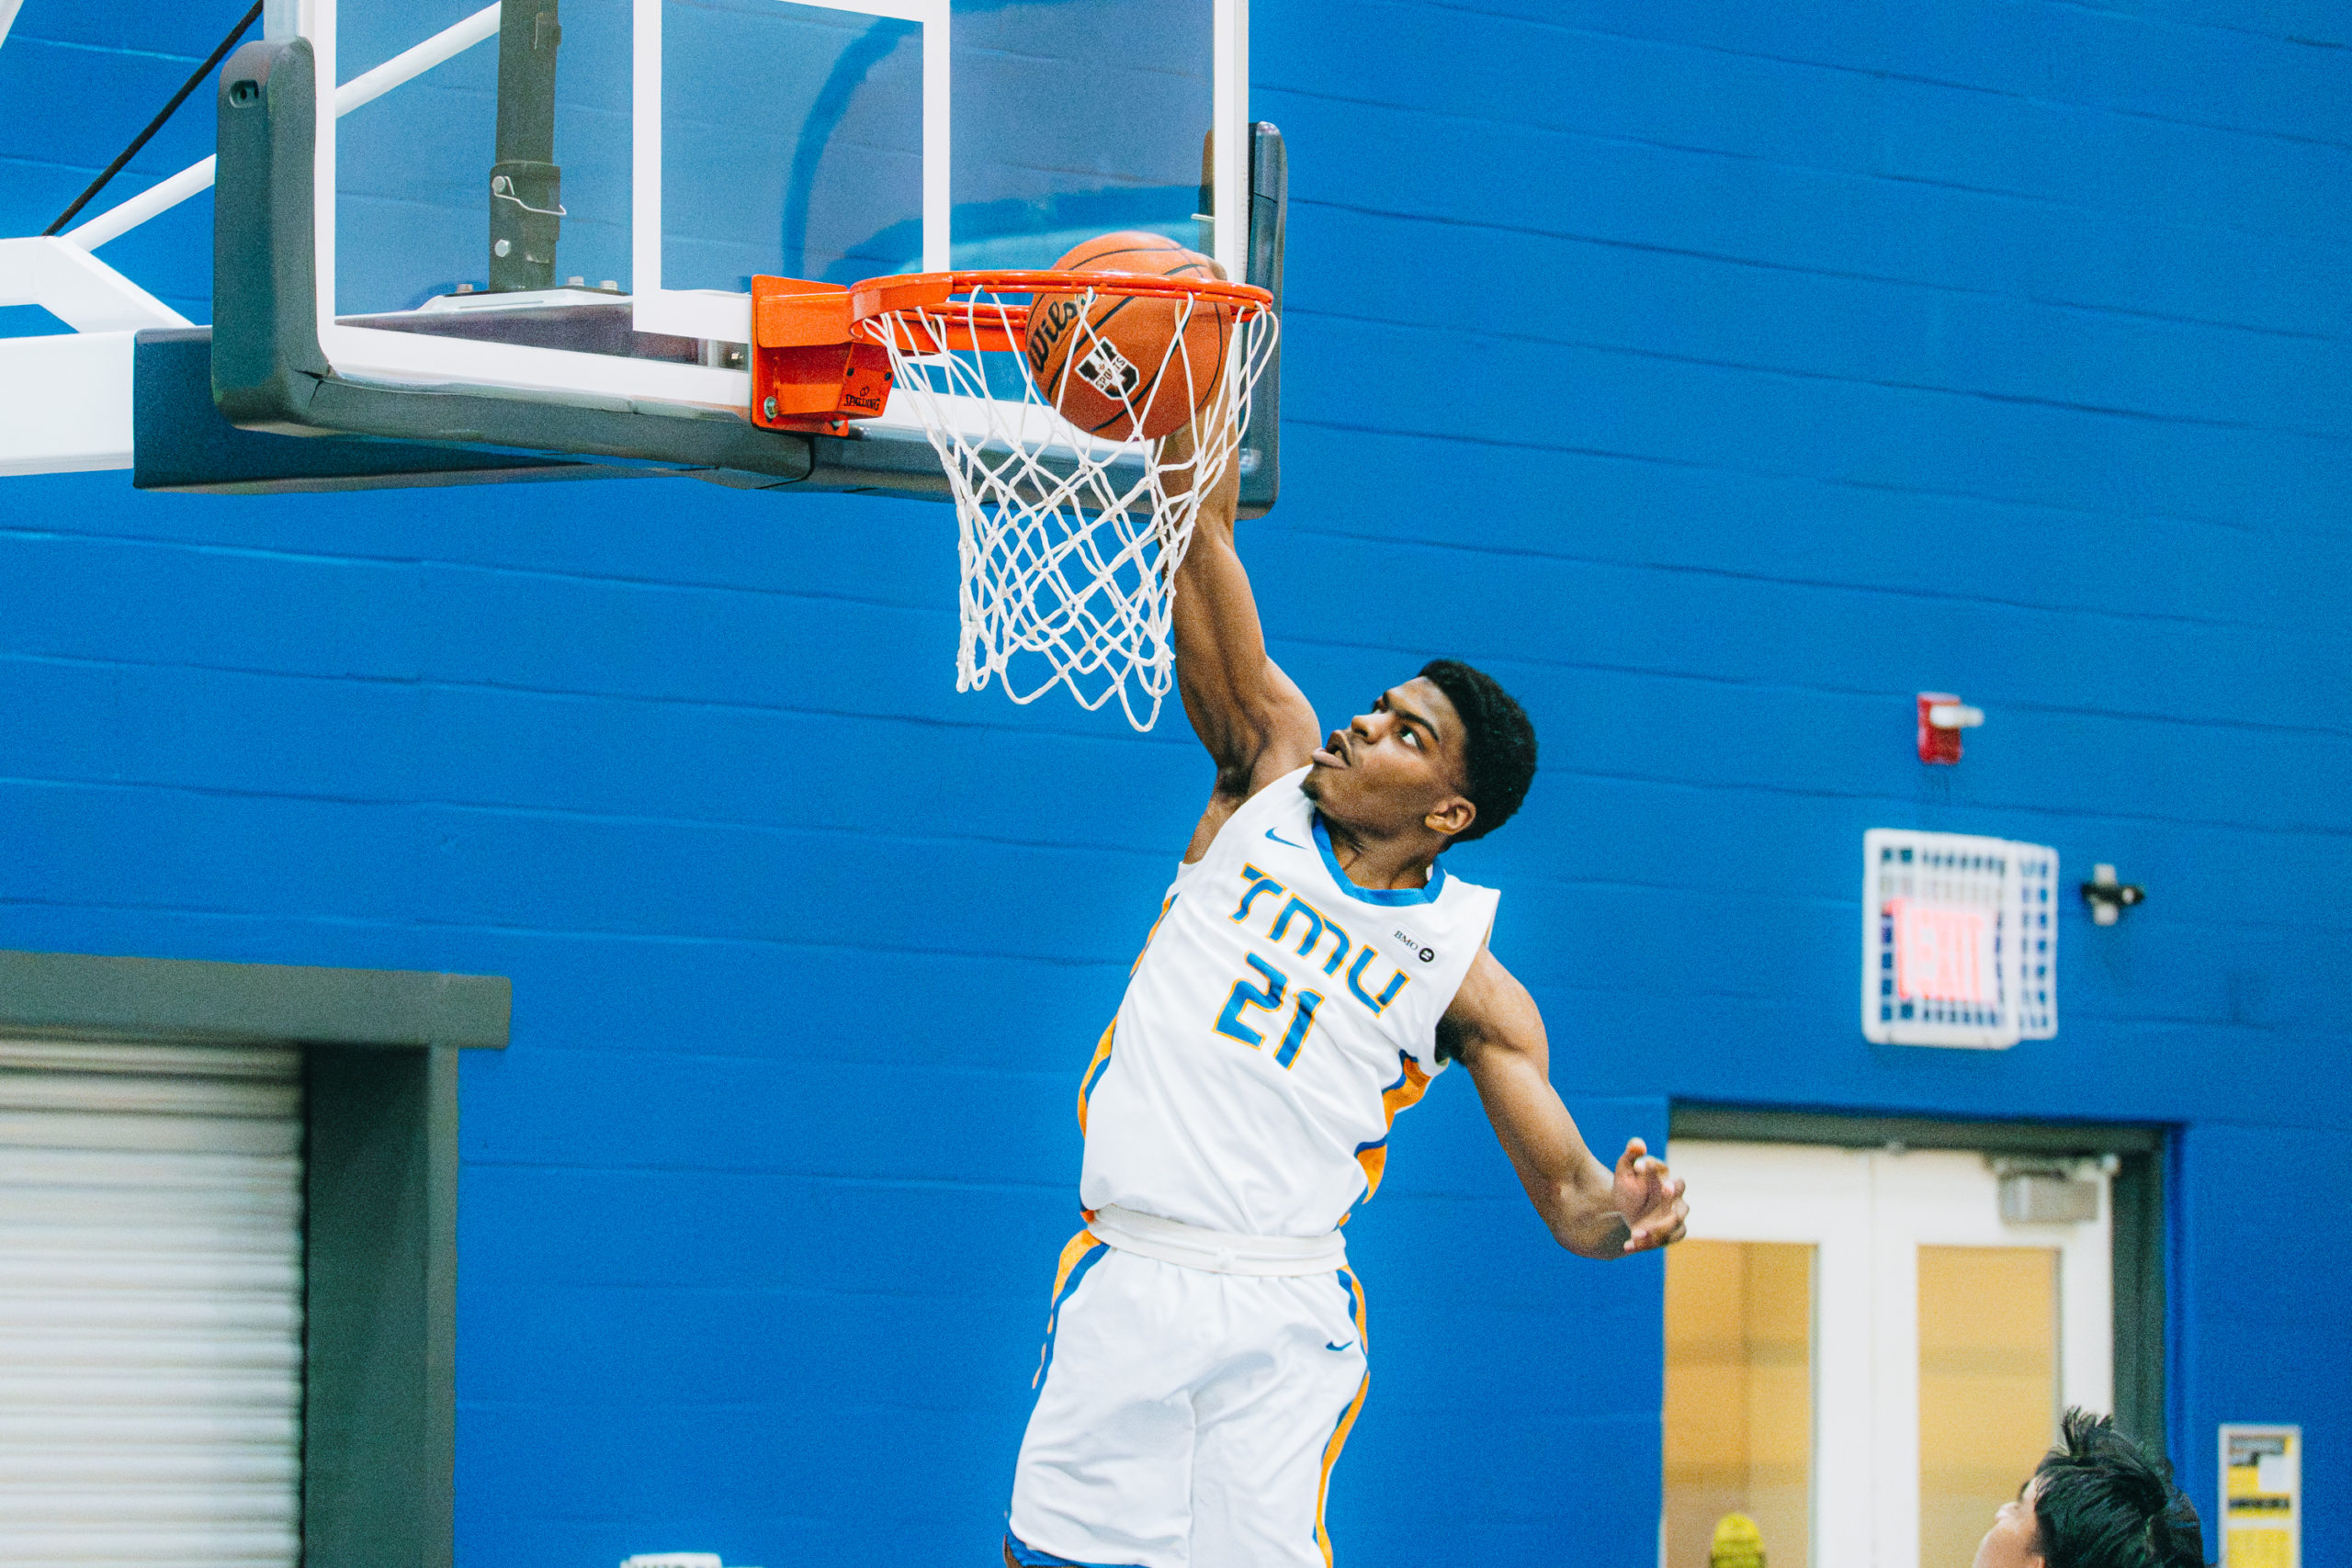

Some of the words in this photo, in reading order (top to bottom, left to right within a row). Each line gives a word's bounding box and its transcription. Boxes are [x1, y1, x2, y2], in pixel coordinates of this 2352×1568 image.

[1027, 300, 1079, 373] Wils
[1094, 356, 1126, 389] SPOTS
[843, 393, 881, 412] SPALDING
[1227, 862, 1410, 1019] TMU
[1394, 930, 1419, 951] BMO
[1910, 909, 1984, 1000] EXIT
[1212, 951, 1325, 1071] 21
